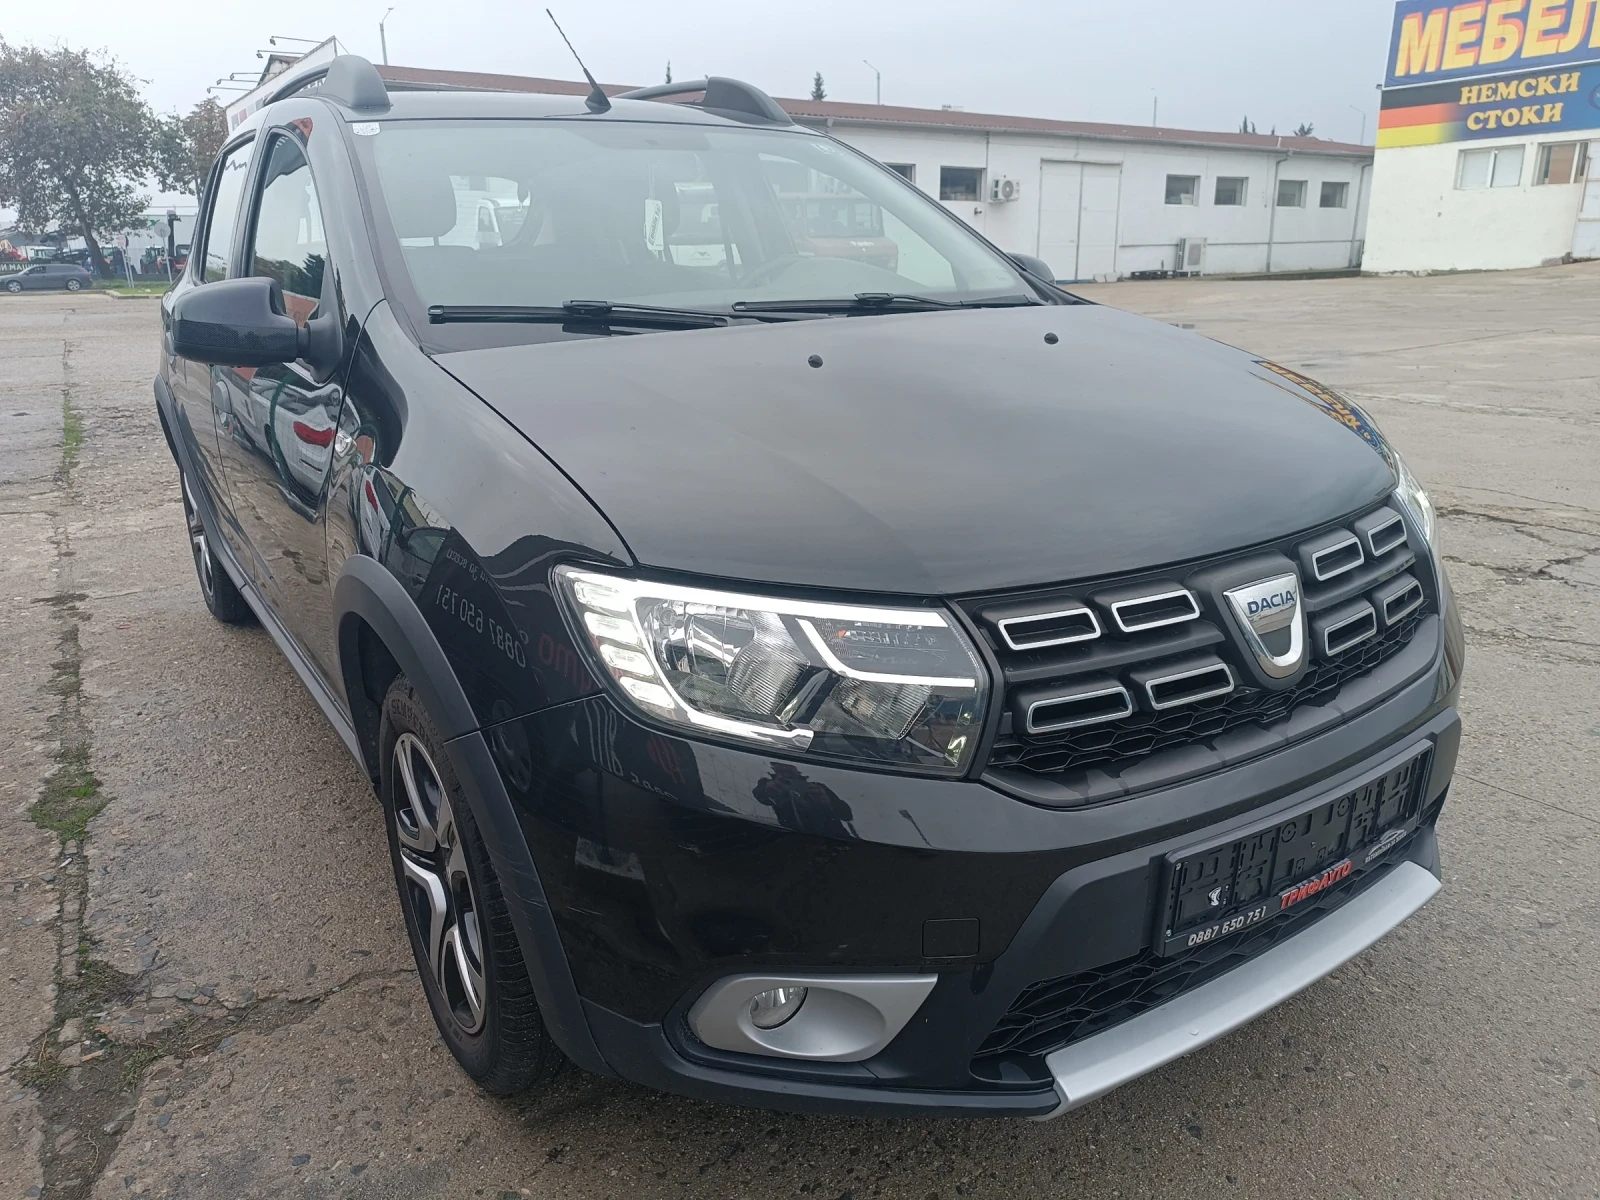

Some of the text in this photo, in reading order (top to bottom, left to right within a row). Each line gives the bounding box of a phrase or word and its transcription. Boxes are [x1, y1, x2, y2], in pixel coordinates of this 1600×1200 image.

[1459, 72, 1581, 105] НЕМСКИ
[1467, 102, 1564, 131] СТОКИ
[1247, 590, 1295, 615] DACIA
[1279, 860, 1352, 909] ТРИФАУТО
[1187, 906, 1267, 946] 0887 650 751
